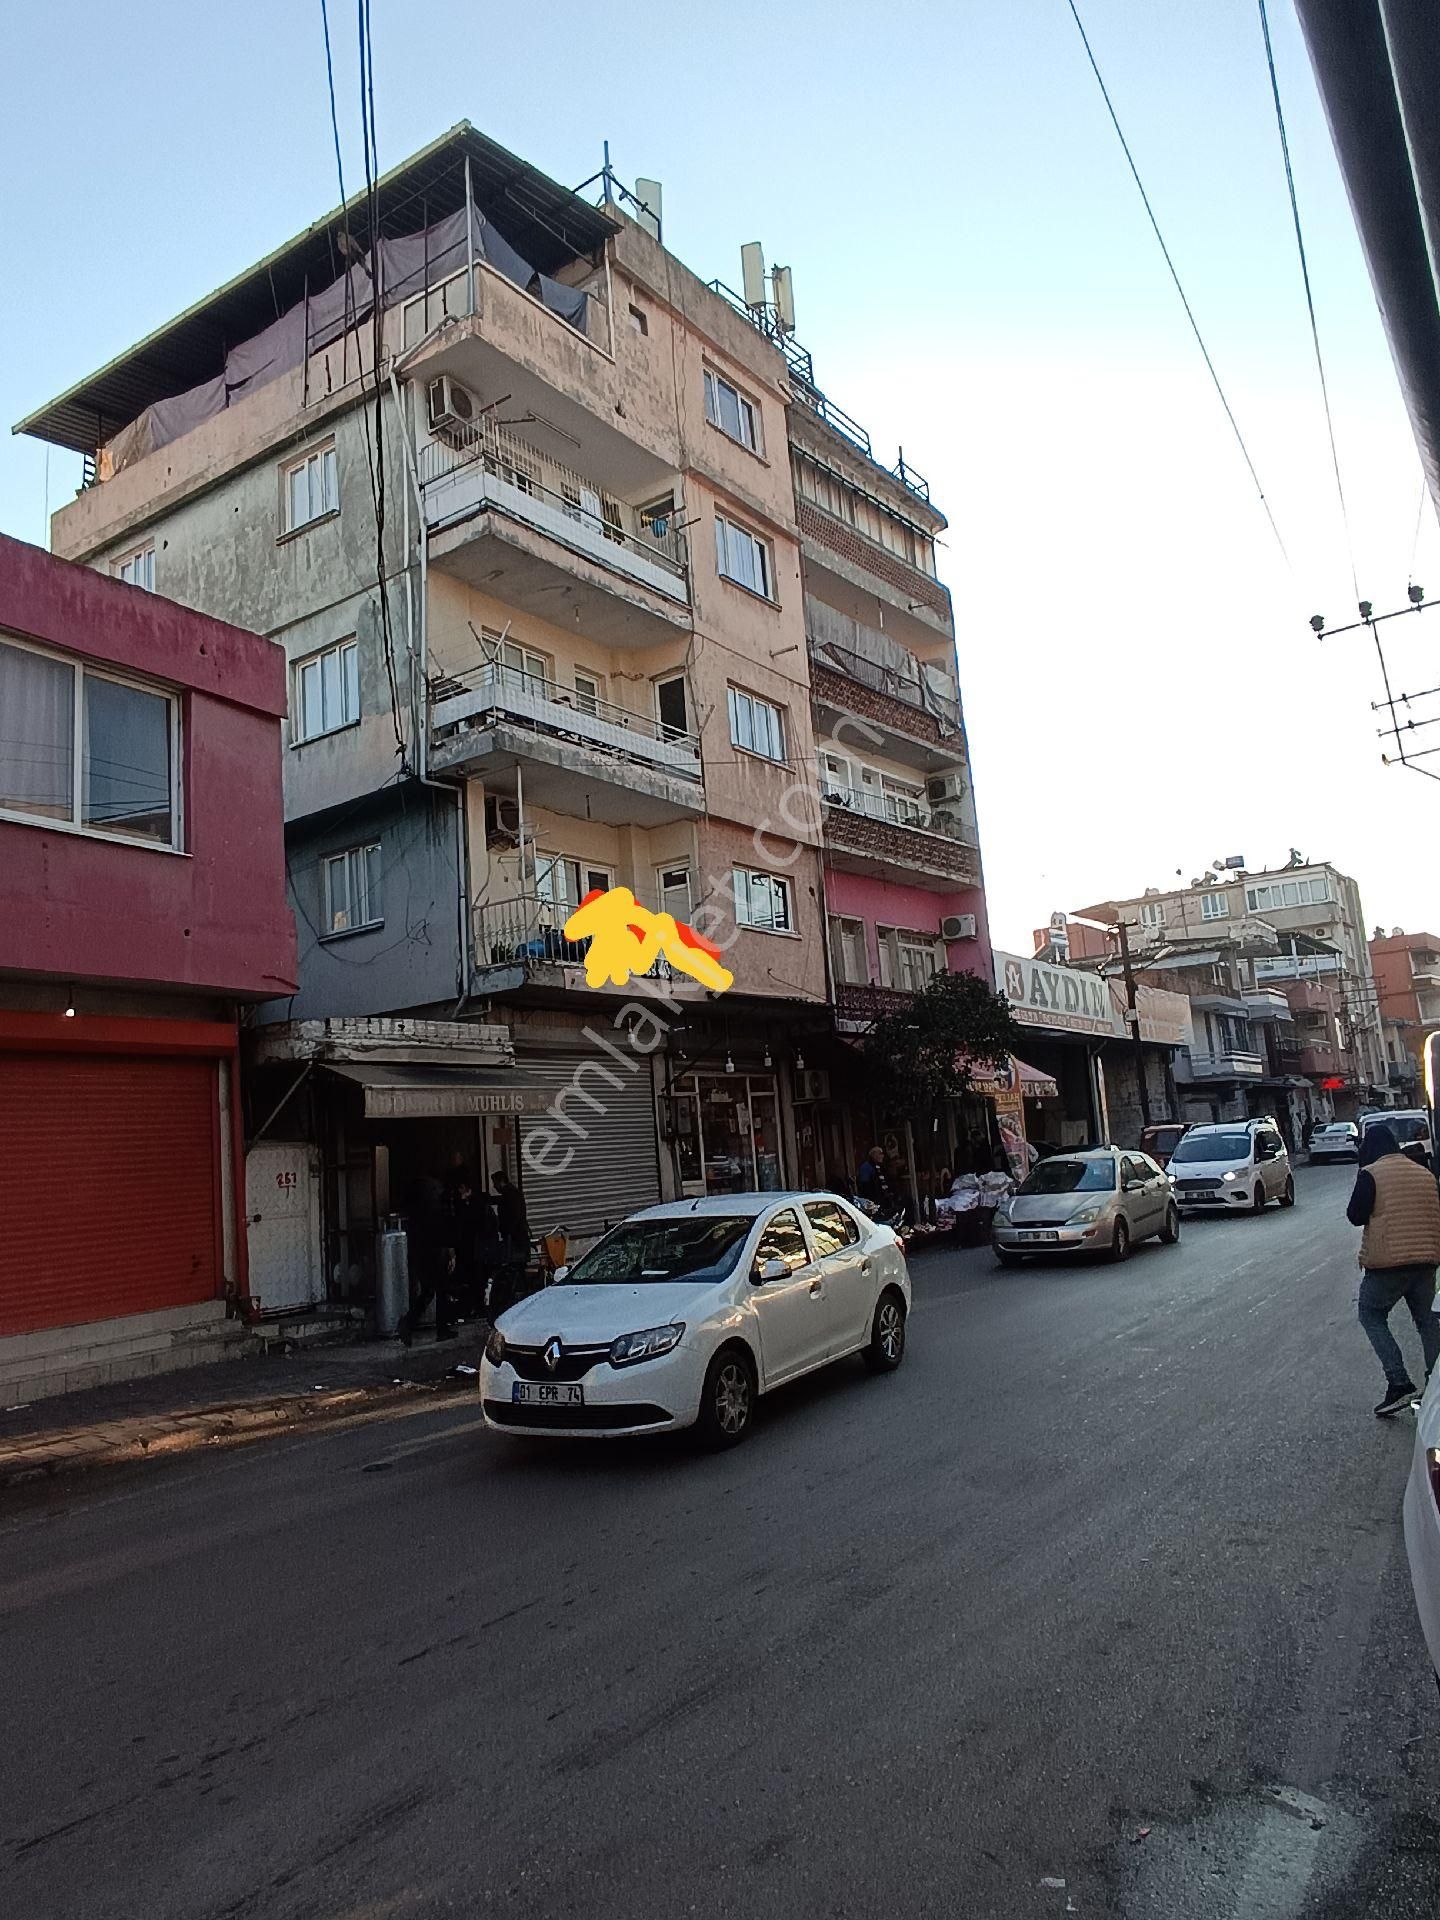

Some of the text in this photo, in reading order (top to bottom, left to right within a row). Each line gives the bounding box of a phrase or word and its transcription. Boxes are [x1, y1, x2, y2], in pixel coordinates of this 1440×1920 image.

[1029, 967, 1105, 1018] AYDIN
[520, 1385, 530, 1400] 01
[539, 1385, 559, 1401] EPR
